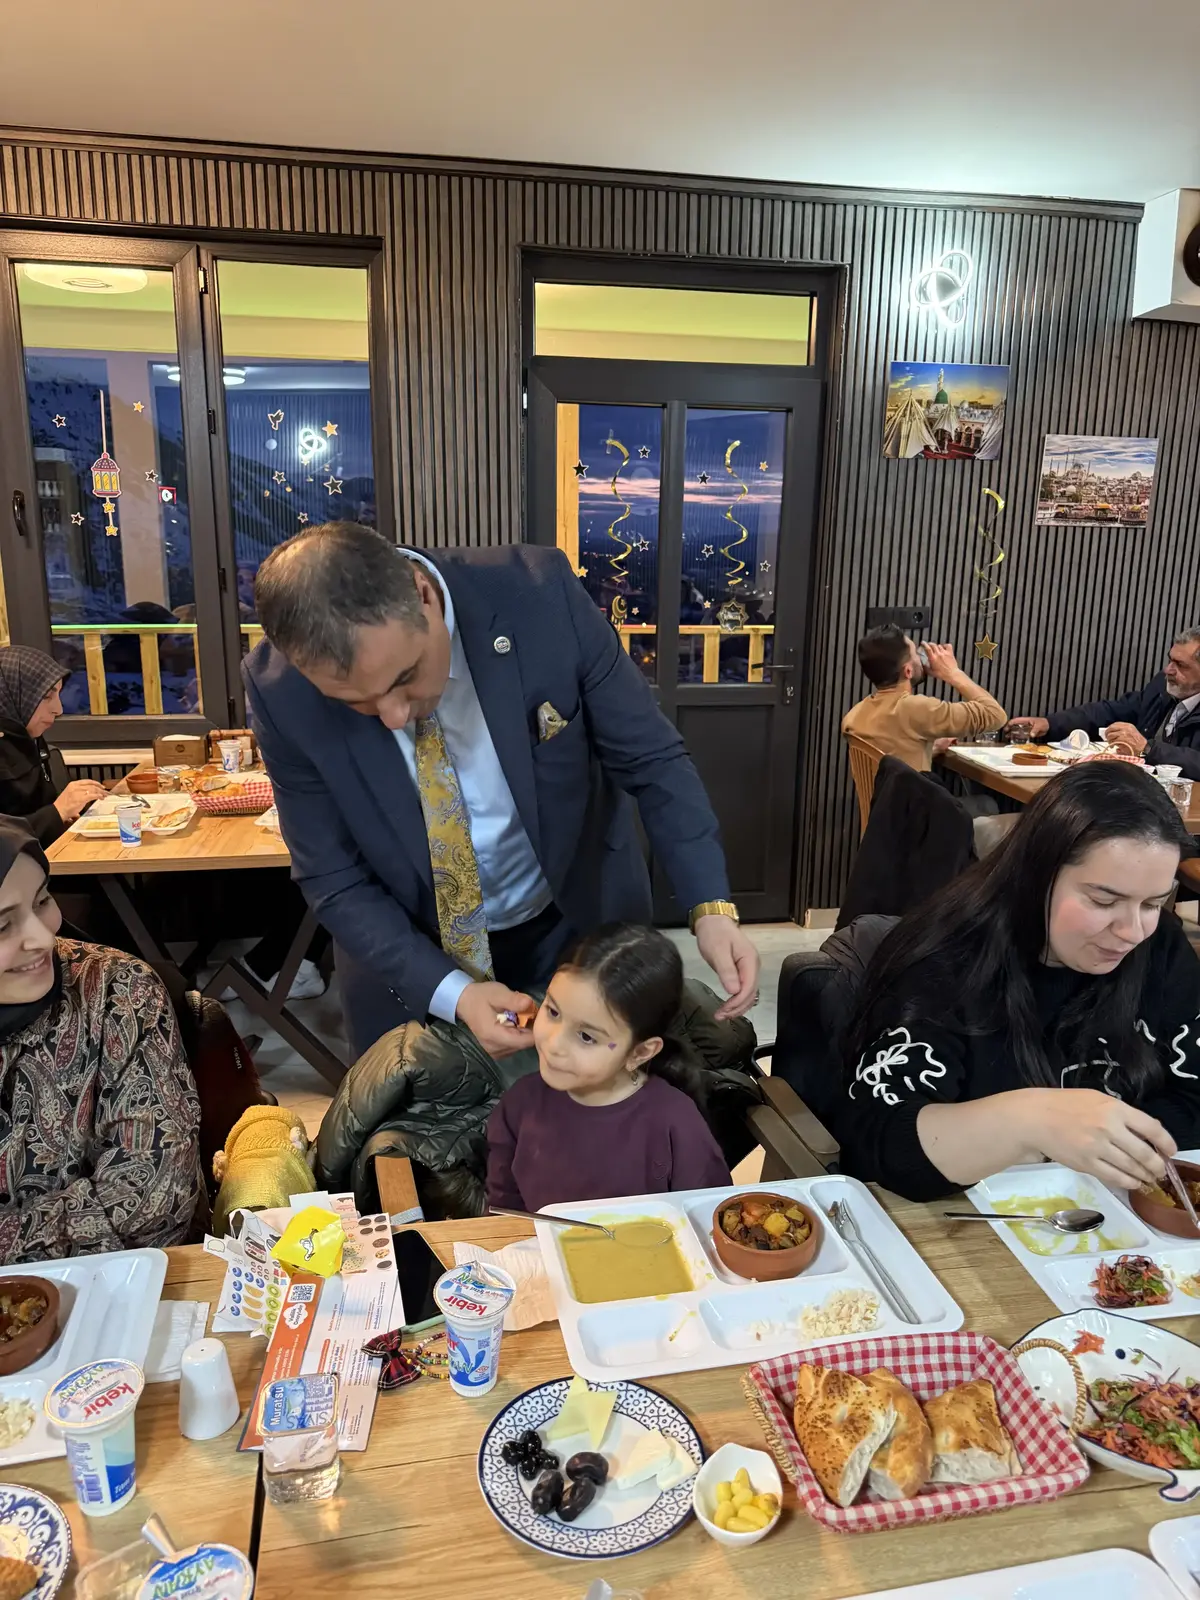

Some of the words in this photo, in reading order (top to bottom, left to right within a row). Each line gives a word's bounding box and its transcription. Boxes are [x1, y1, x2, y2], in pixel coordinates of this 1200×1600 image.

[444, 1295, 487, 1316] kebir
[83, 1382, 136, 1420] kebir
[269, 1386, 285, 1426] Muratsu
[153, 1554, 215, 1598] AYRAN
